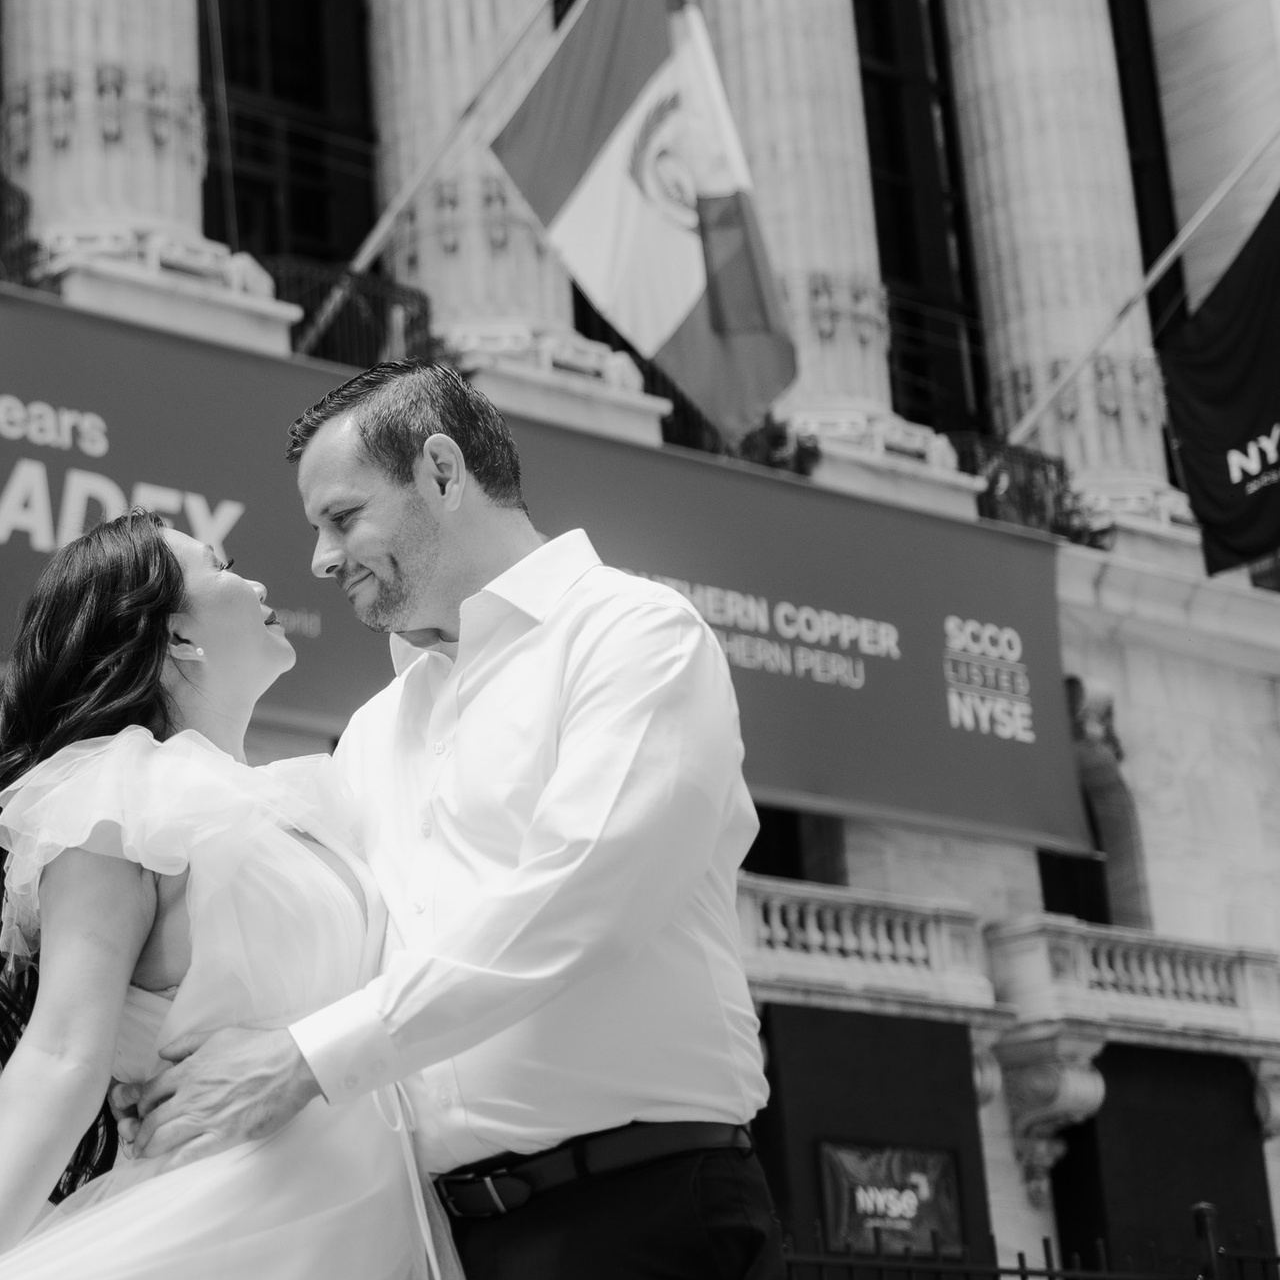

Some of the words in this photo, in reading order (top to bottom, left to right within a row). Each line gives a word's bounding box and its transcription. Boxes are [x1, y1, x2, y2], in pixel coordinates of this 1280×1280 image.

[773, 600, 901, 661] COPPER
[944, 614, 1023, 663] SCCO
[793, 645, 866, 691] PERU
[943, 658, 1030, 696] LISTED
[946, 690, 1037, 745] NYSE
